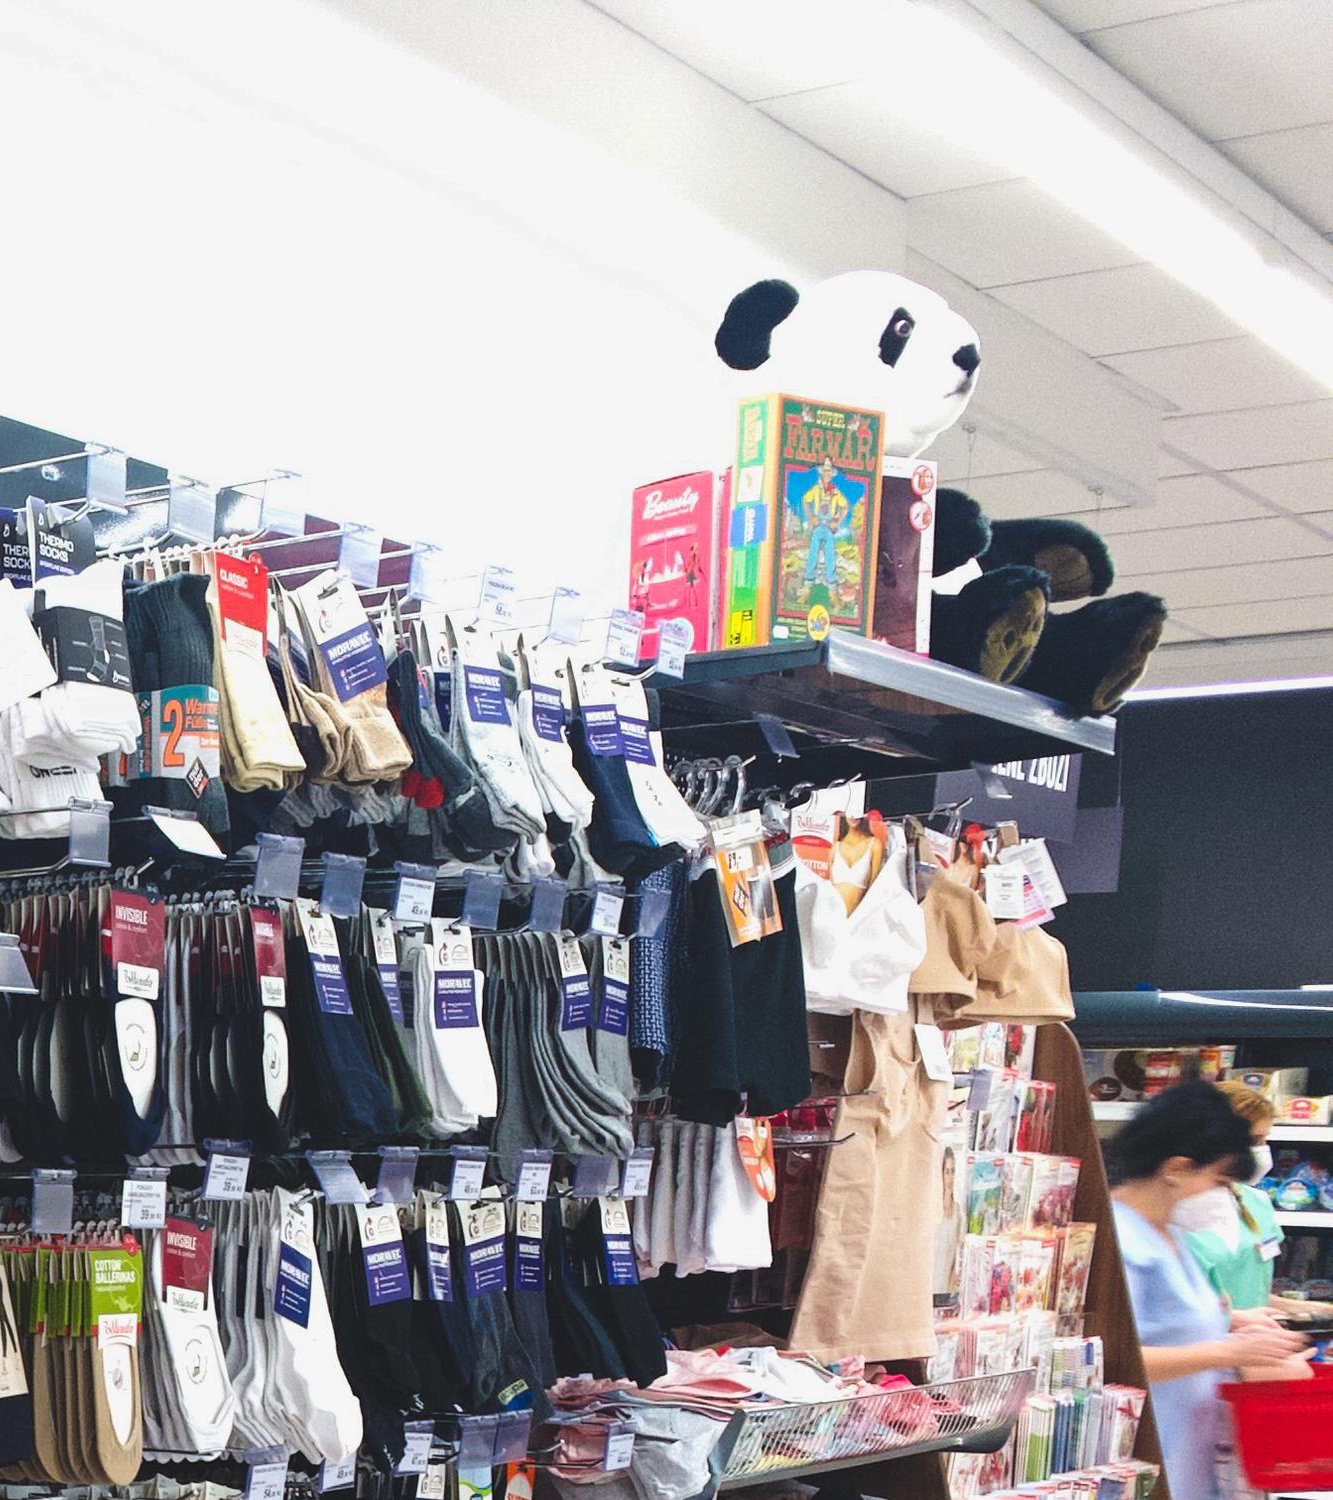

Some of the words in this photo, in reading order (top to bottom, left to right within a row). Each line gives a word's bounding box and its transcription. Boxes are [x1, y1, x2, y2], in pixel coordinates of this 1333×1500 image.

[784, 413, 874, 470] FARMAR
[3, 543, 30, 556] THER
[39, 531, 74, 552] THERMO
[39, 544, 69, 563] SOCKS
[3, 556, 31, 570] SOCK
[163, 698, 185, 767] 2
[95, 1258, 123, 1273] COTTON
[95, 1270, 136, 1285] BALLERINAS
